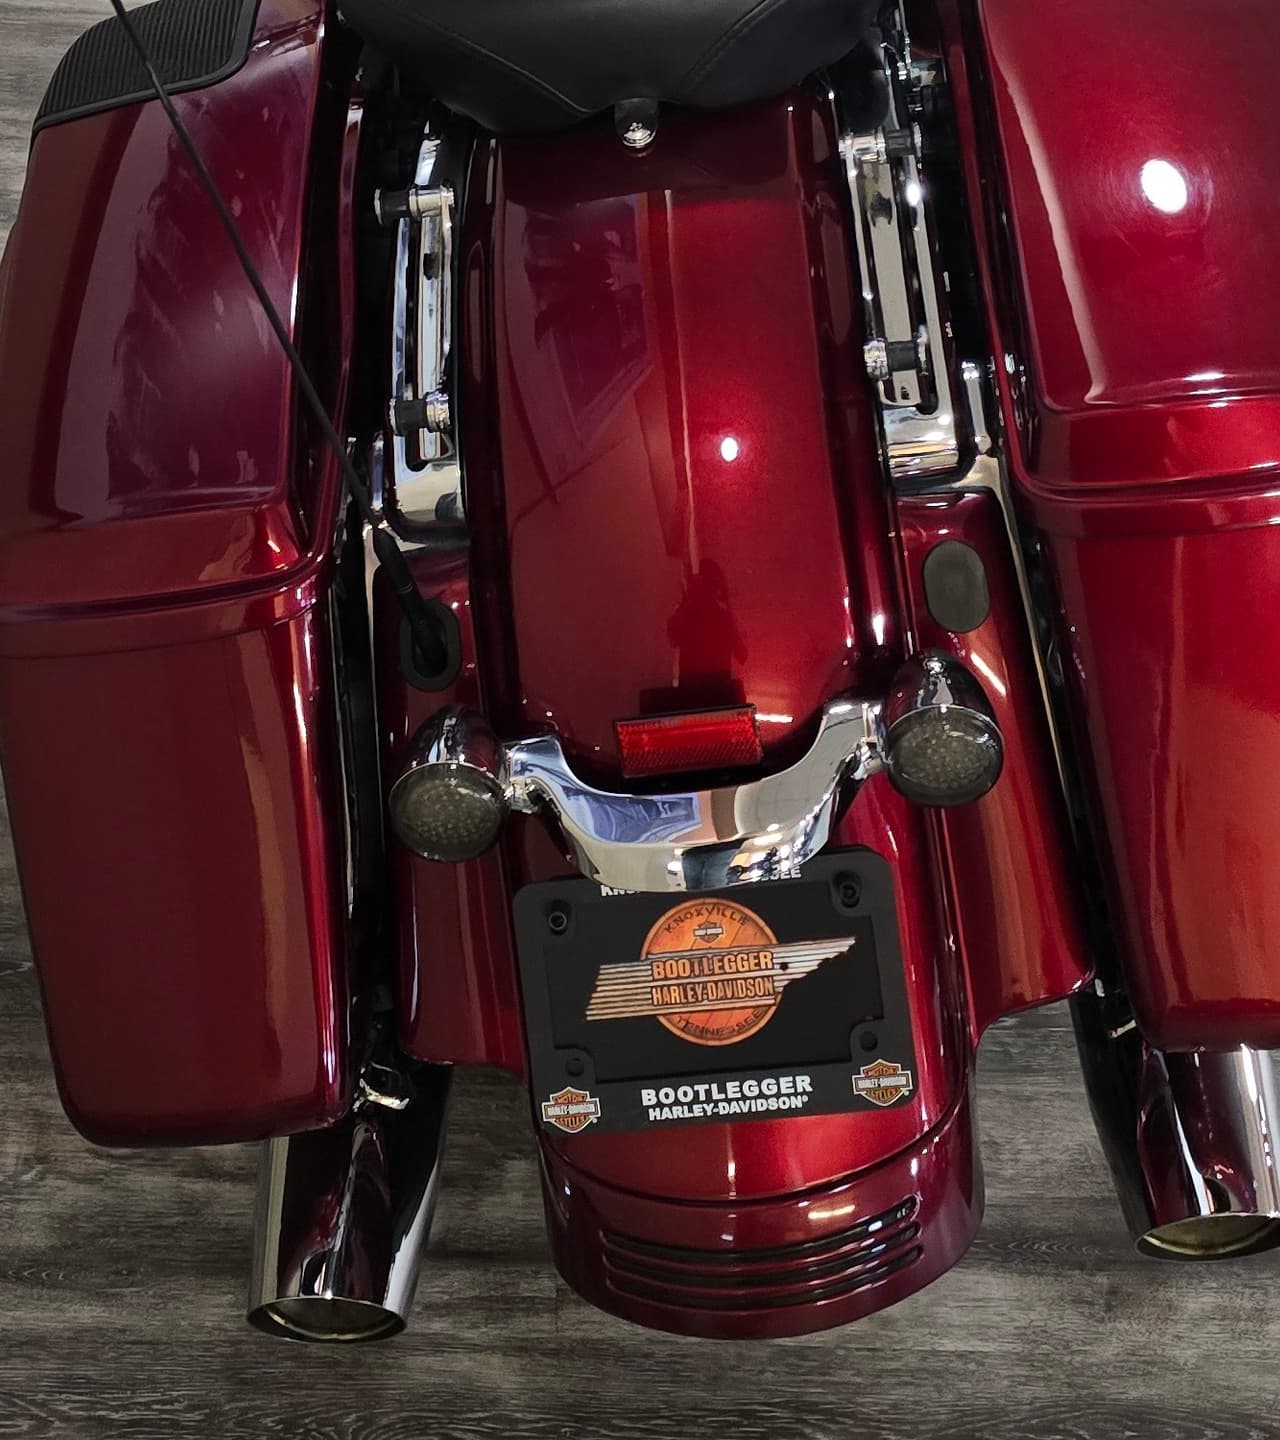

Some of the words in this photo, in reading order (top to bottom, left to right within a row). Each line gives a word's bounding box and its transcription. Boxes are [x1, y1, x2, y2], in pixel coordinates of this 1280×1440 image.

[663, 906, 750, 934] KNOXVILLE
[651, 951, 774, 981] BOOTLEGGER
[651, 977, 775, 1006] HARLEY-DAVIDSON
[641, 1075, 813, 1106] BOOTLEGGER
